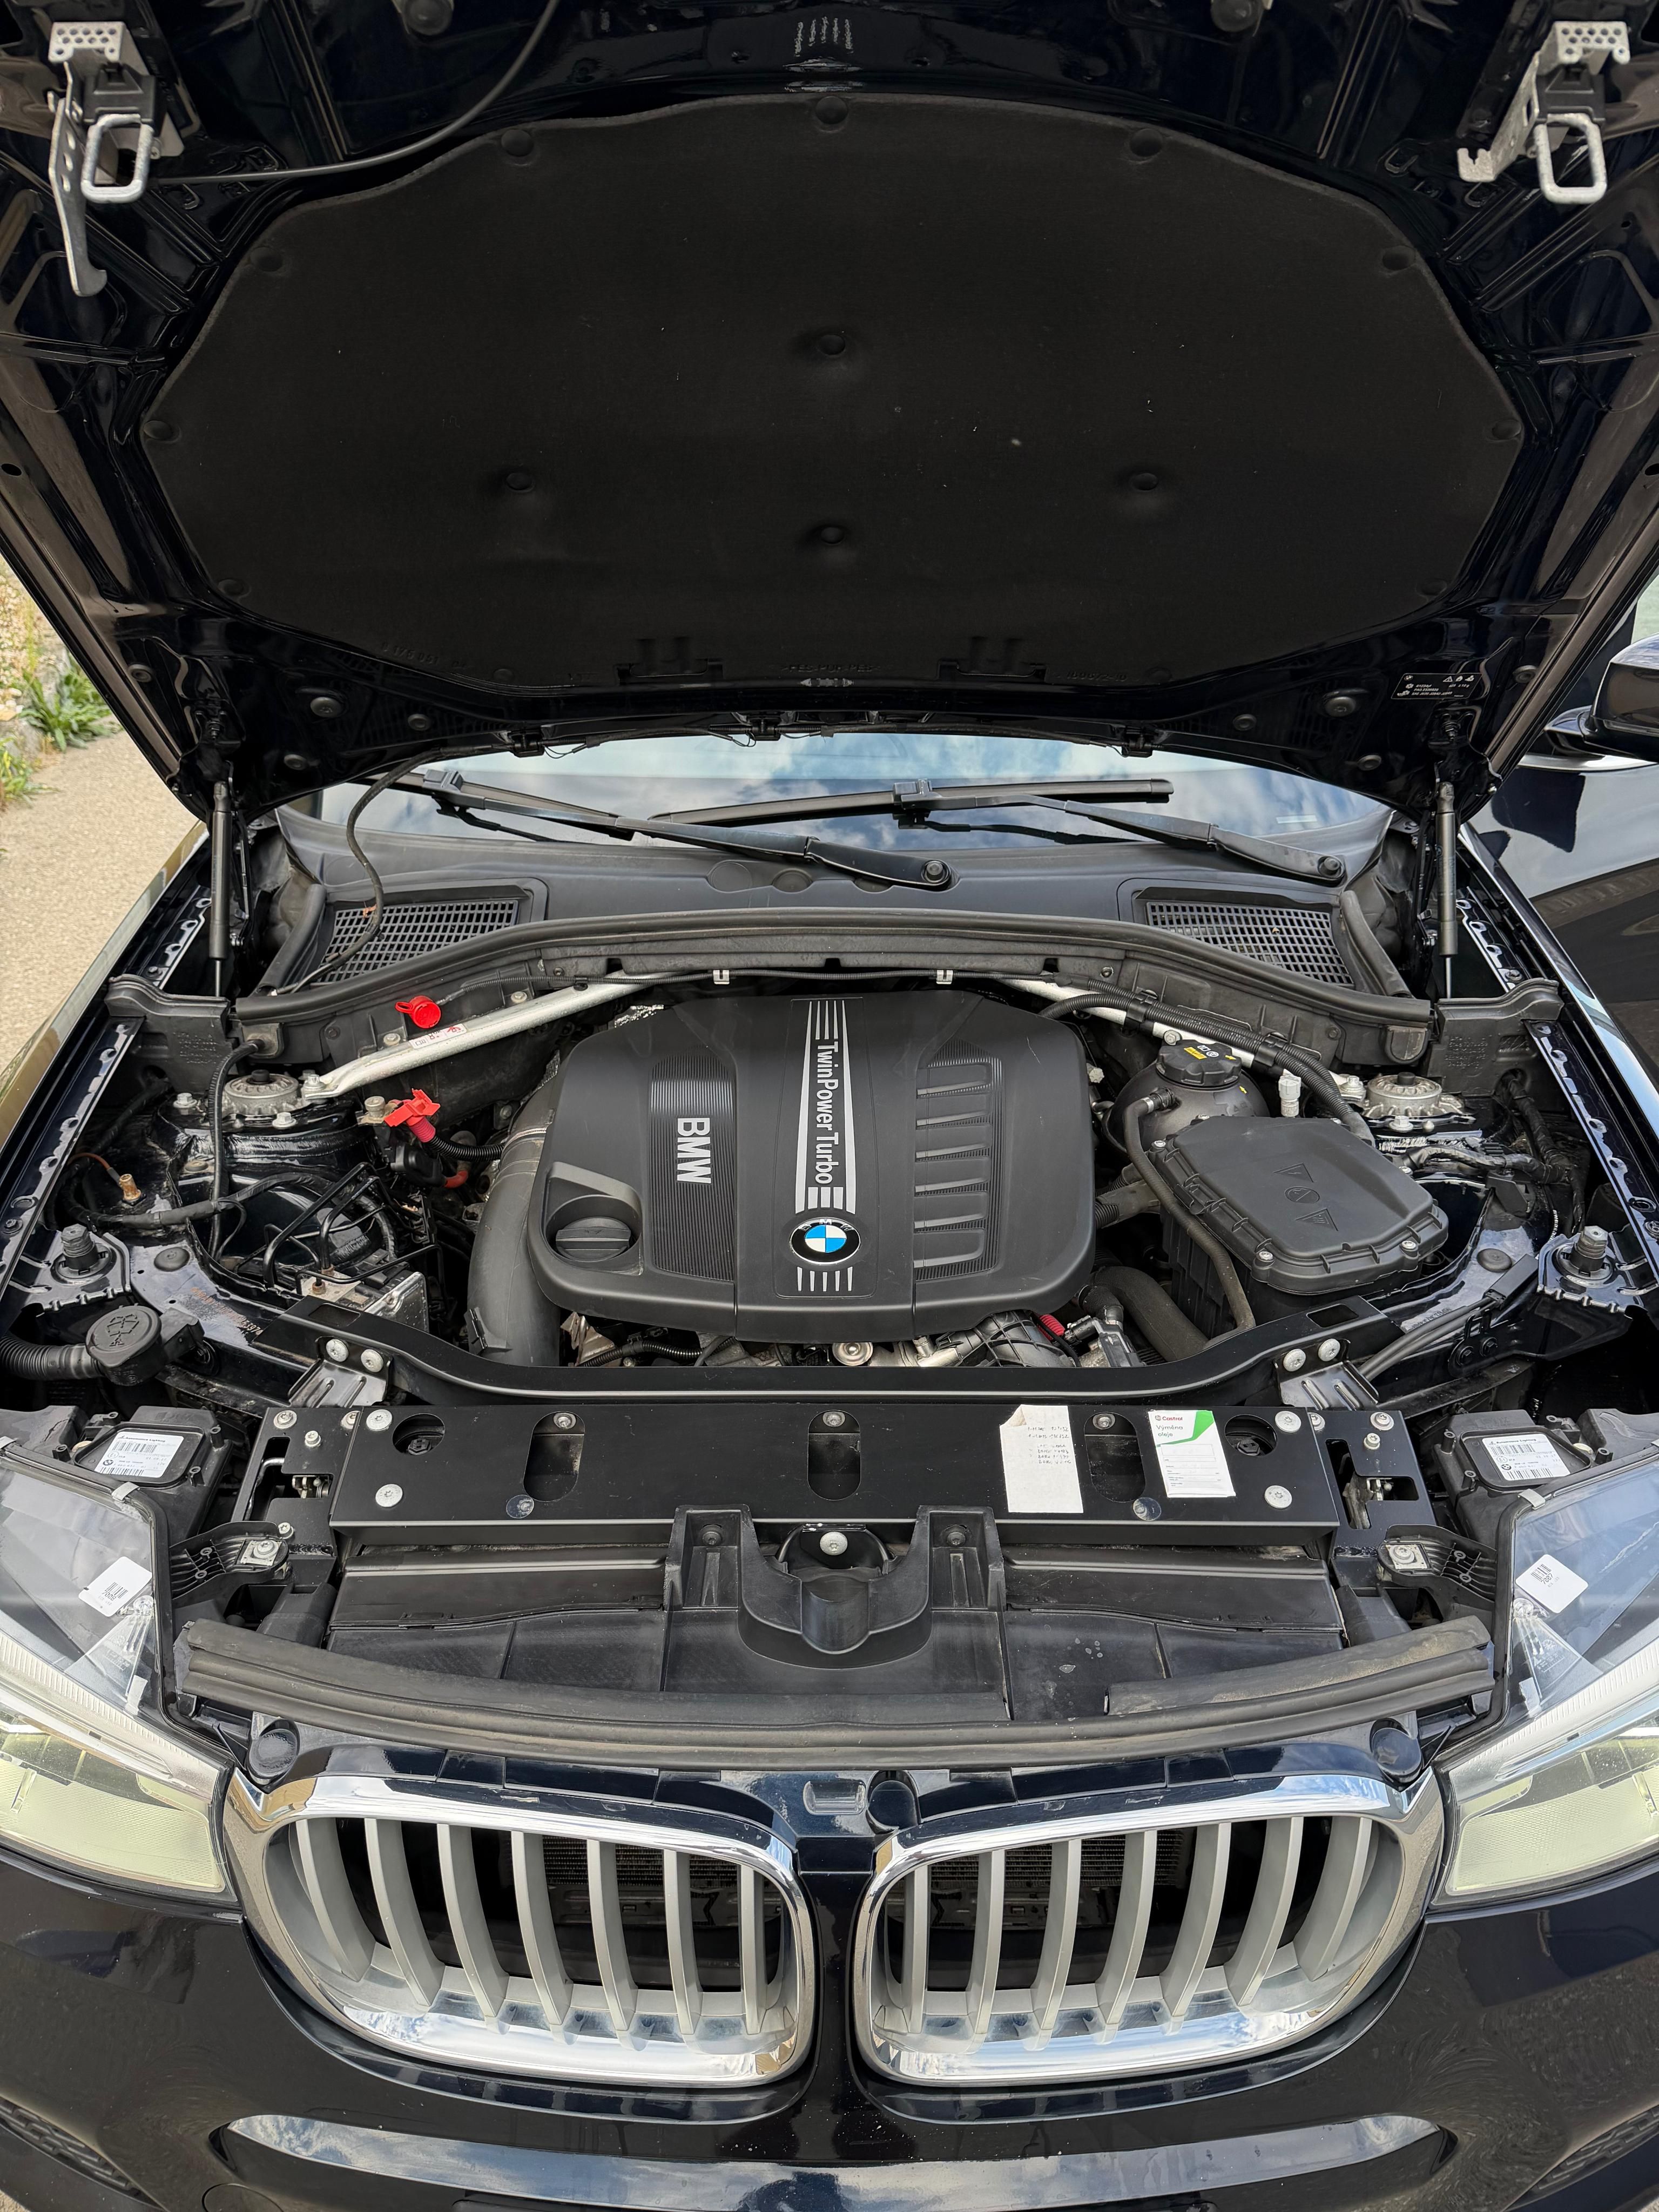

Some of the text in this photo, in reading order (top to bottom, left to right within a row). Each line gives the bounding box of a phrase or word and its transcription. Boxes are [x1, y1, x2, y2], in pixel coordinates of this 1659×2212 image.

[677, 1117, 712, 1184] BMW
[815, 1041, 839, 1185] TwinPower Turbo
